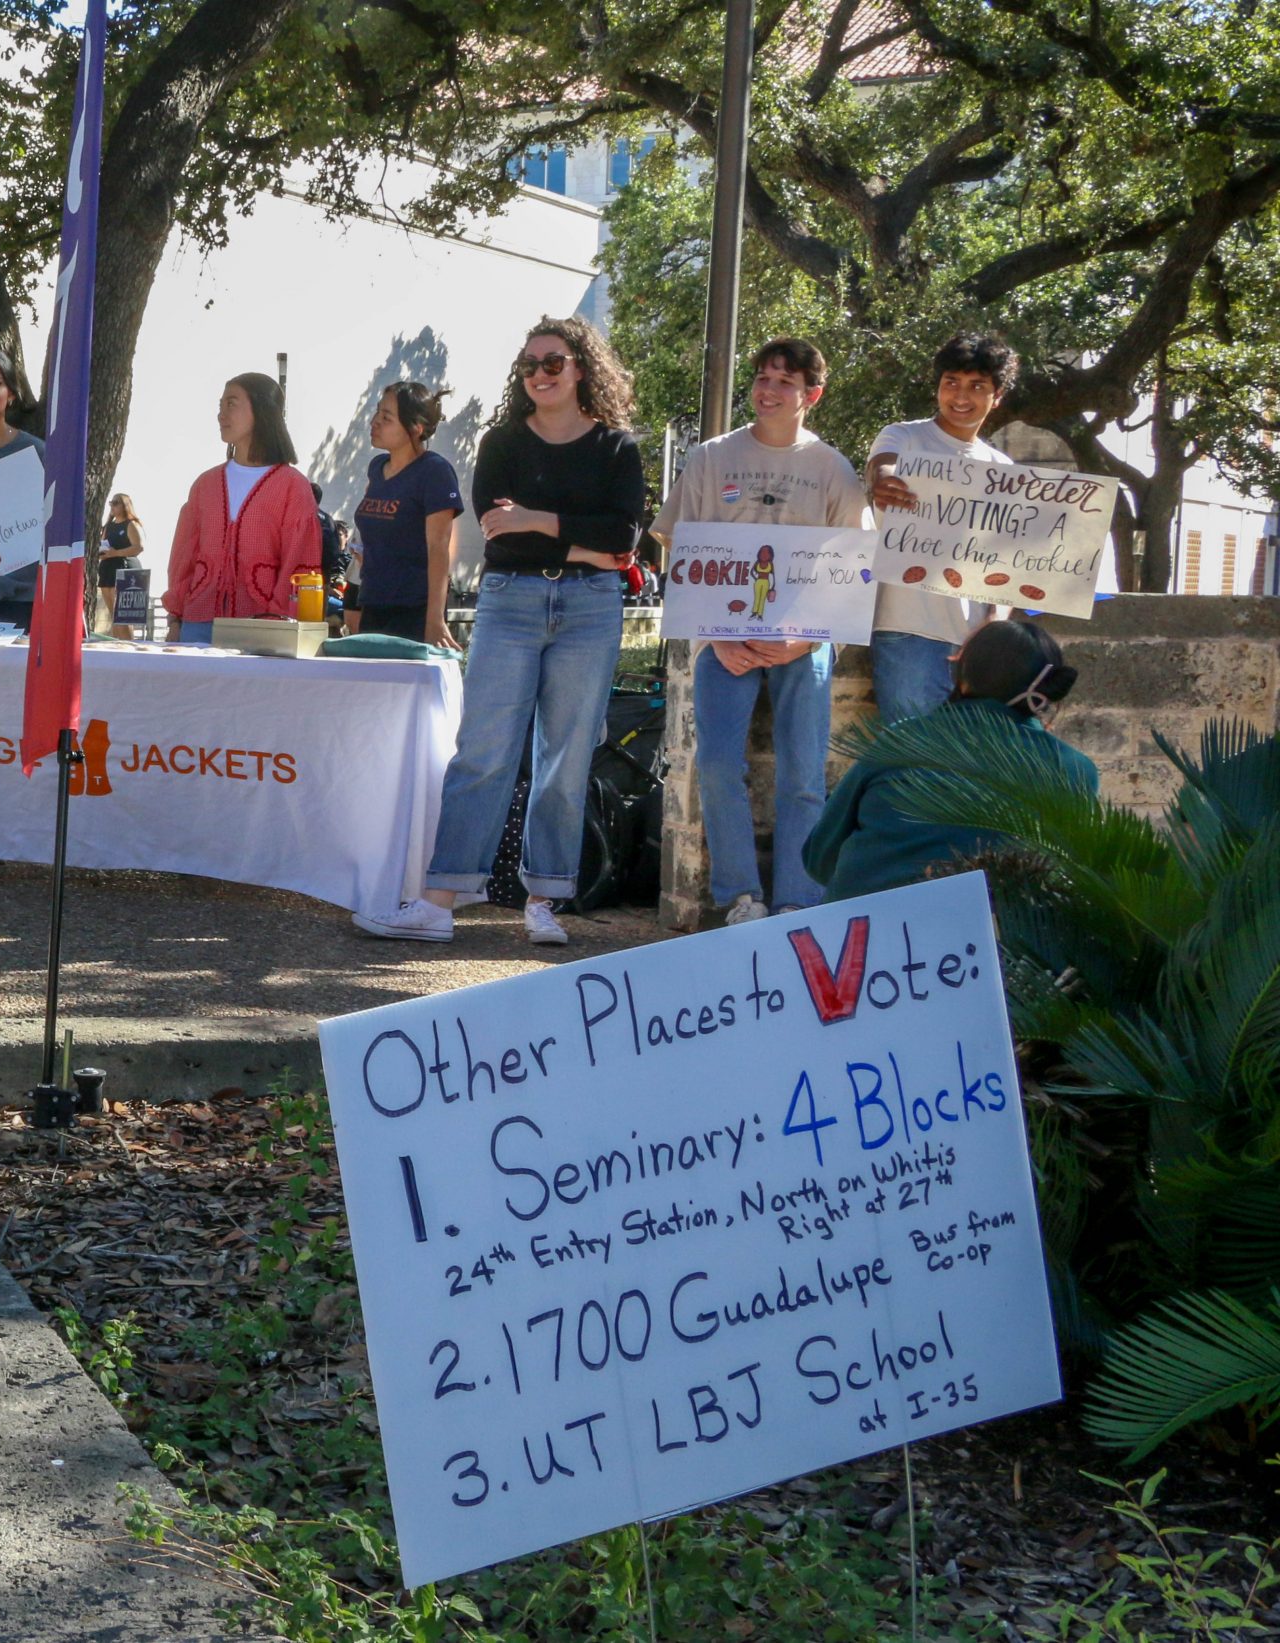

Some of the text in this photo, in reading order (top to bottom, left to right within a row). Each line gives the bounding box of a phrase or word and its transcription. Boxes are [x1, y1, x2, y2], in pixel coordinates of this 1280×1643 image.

[983, 466, 1106, 513] sweeter
[936, 493, 1040, 540] VOTING?
[1046, 511, 1068, 541] A
[670, 558, 751, 587] COOKIE
[785, 566, 856, 586] behind YOU
[790, 549, 868, 560] mama a
[120, 743, 298, 784] JACKETS
[362, 914, 982, 1118] Other Places to Vote:
[399, 1041, 1008, 1244] 1. Seminary: 4 Blocks
[445, 1144, 957, 1297] 24th Entry Station, North on Whitis
[777, 1168, 954, 1245] Right at 27th
[909, 1208, 1016, 1254] Bus from
[668, 1259, 892, 1344] Guadalupe
[652, 1362, 763, 1457] LBJ
[795, 1309, 955, 1407] School
[857, 1374, 980, 1435] at I-35
